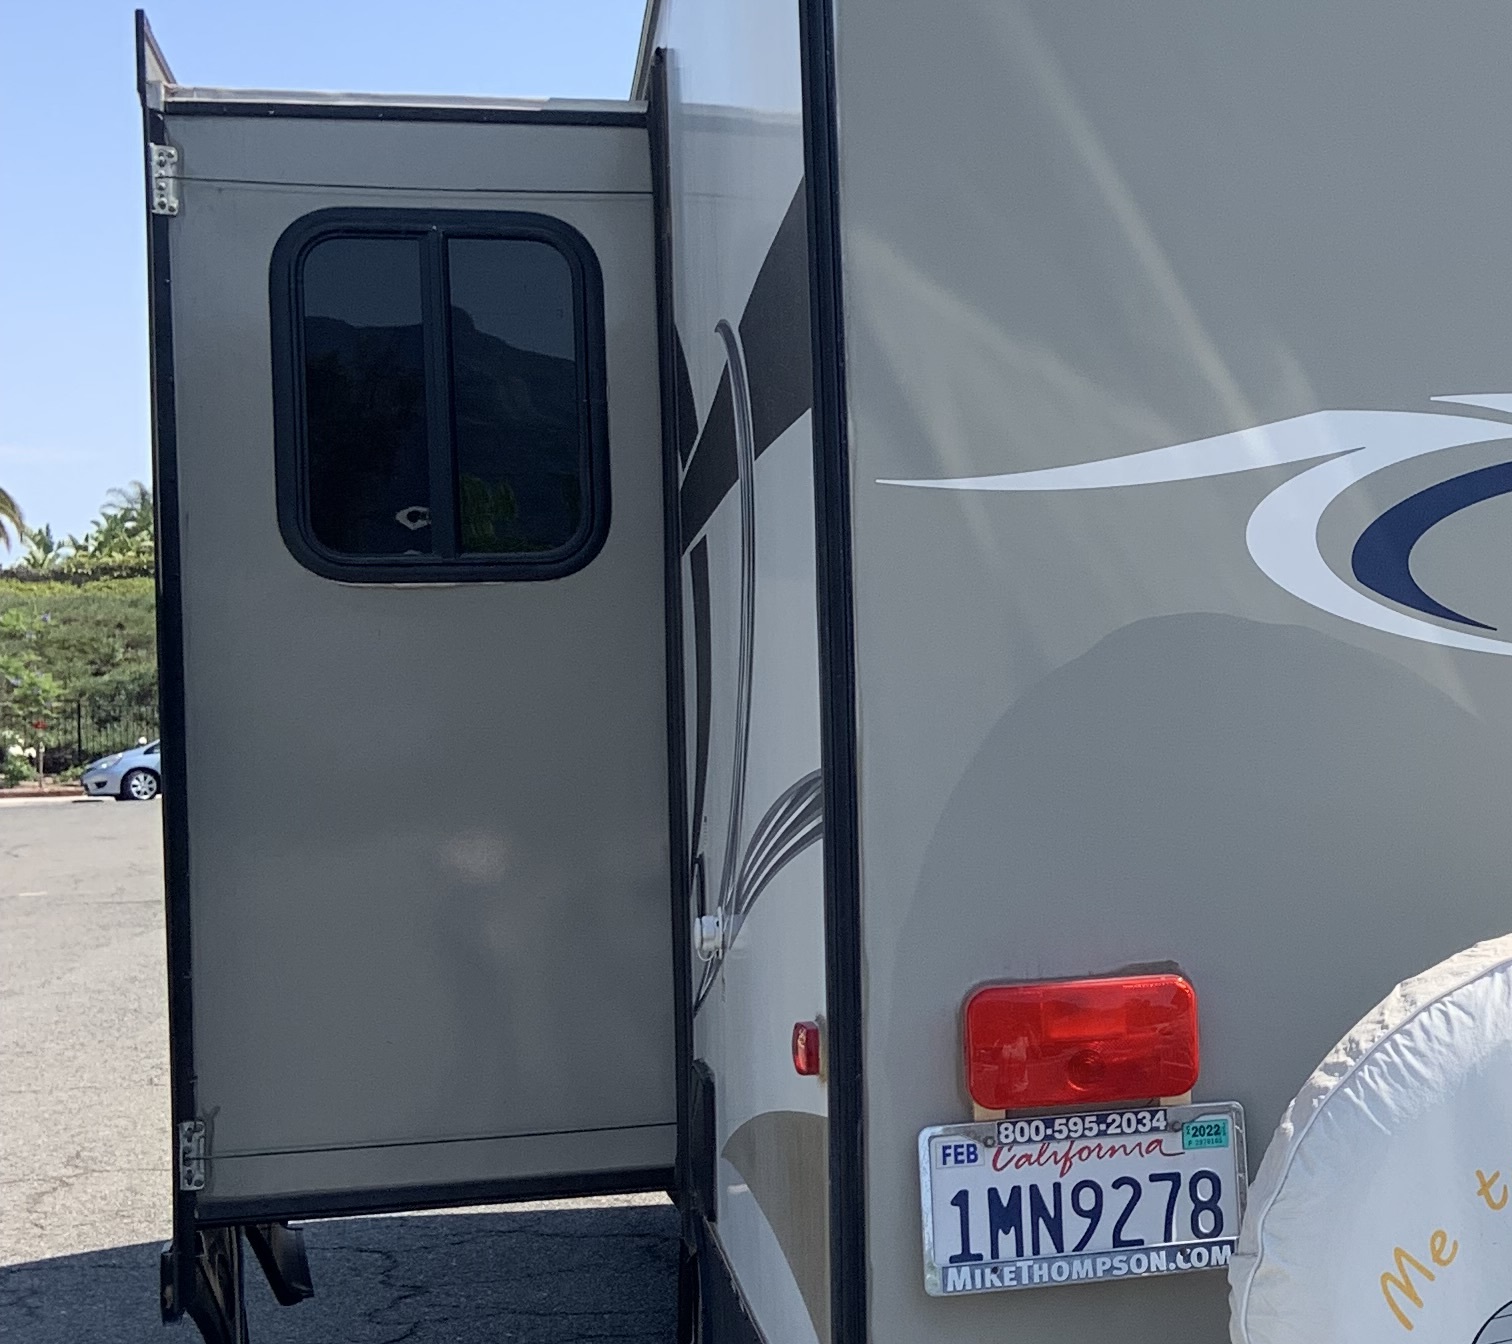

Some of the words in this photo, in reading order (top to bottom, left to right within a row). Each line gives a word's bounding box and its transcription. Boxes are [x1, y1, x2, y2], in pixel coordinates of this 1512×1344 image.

[999, 1111, 1167, 1144] 800-595-2034
[1191, 1123, 1221, 1137] 2022
[941, 1143, 979, 1167] FEB
[991, 1137, 1186, 1179] California
[948, 1169, 1225, 1264] 1MN9278
[1379, 1228, 1459, 1332] Me
